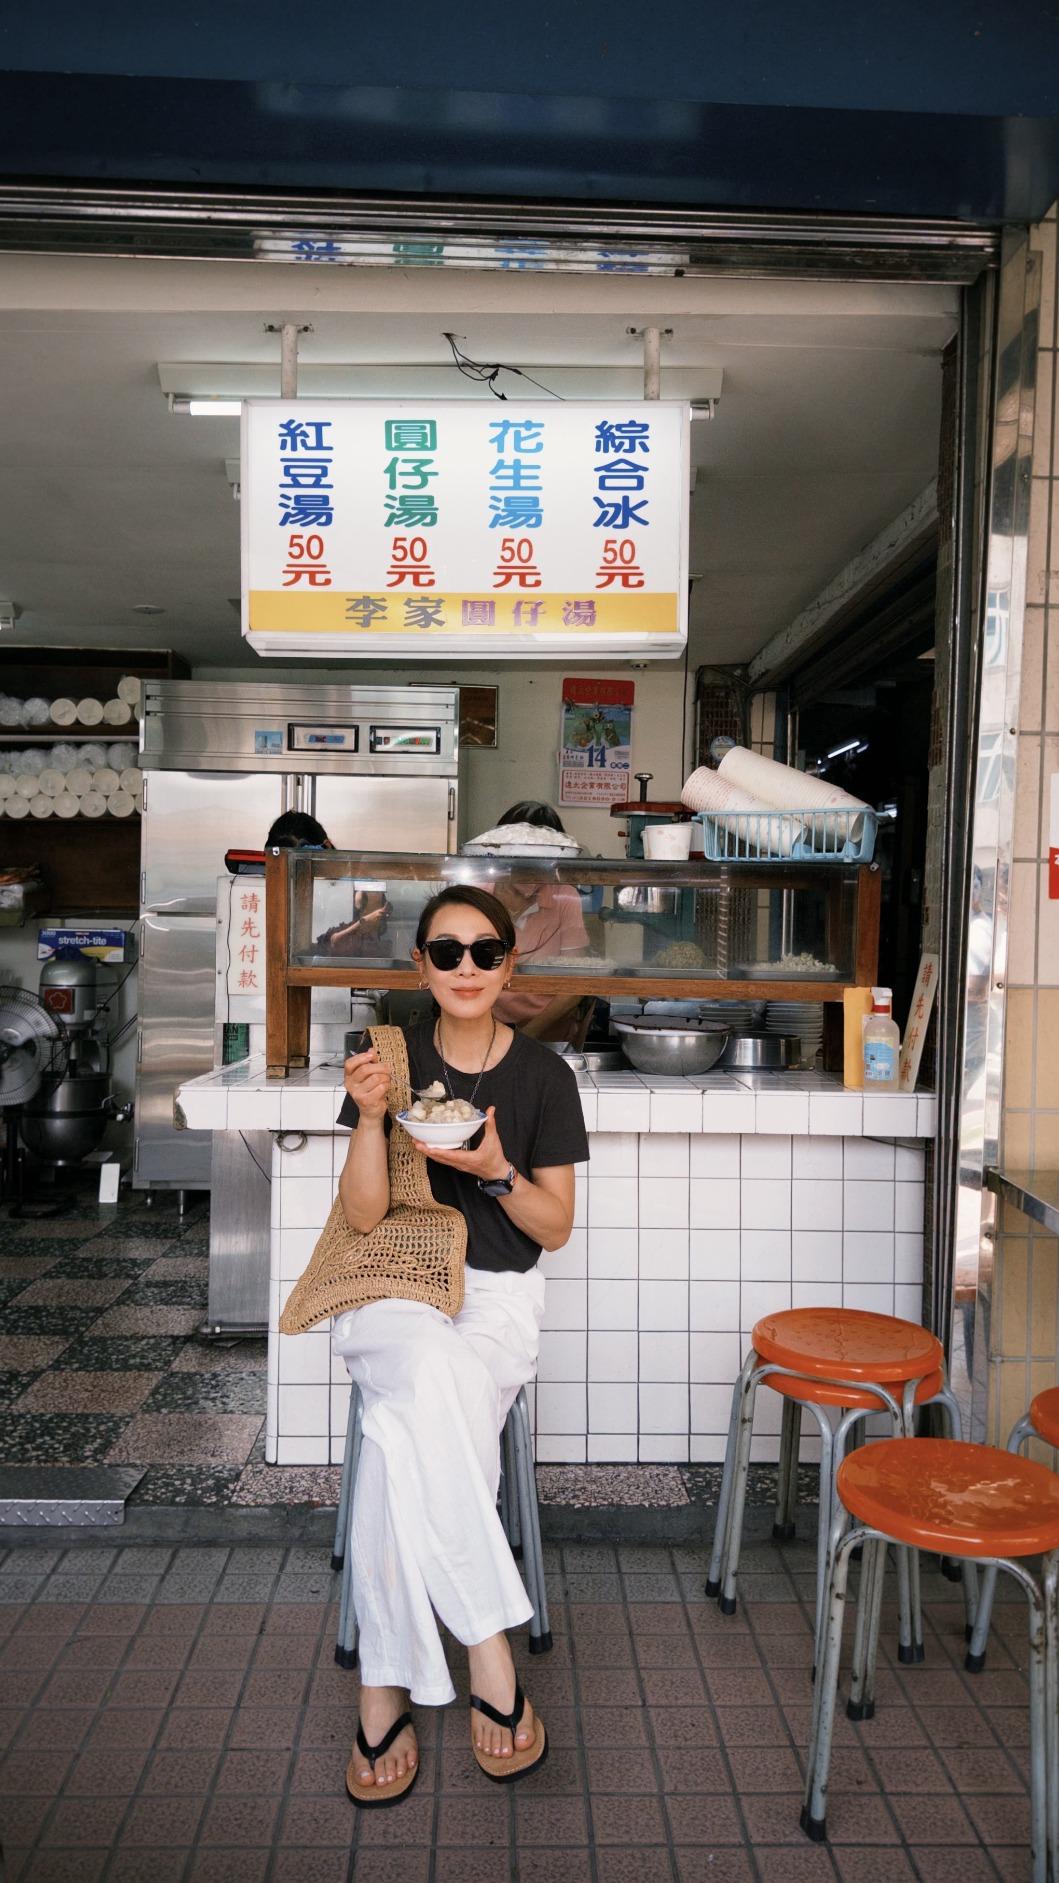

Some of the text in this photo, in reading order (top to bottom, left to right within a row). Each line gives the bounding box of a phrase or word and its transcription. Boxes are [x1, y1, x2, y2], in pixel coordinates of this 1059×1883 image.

[278, 419, 334, 587] 紅豆湯 50 元
[384, 419, 439, 588] 圓仔湯 50 元
[488, 420, 544, 589] 花生湯 50 元
[592, 420, 650, 589] 綜合冰 50 元
[586, 745, 607, 768] 14
[58, 935, 107, 946] stretch-tite
[238, 892, 261, 989] 請先付款
[900, 962, 934, 1083] 請先付款
